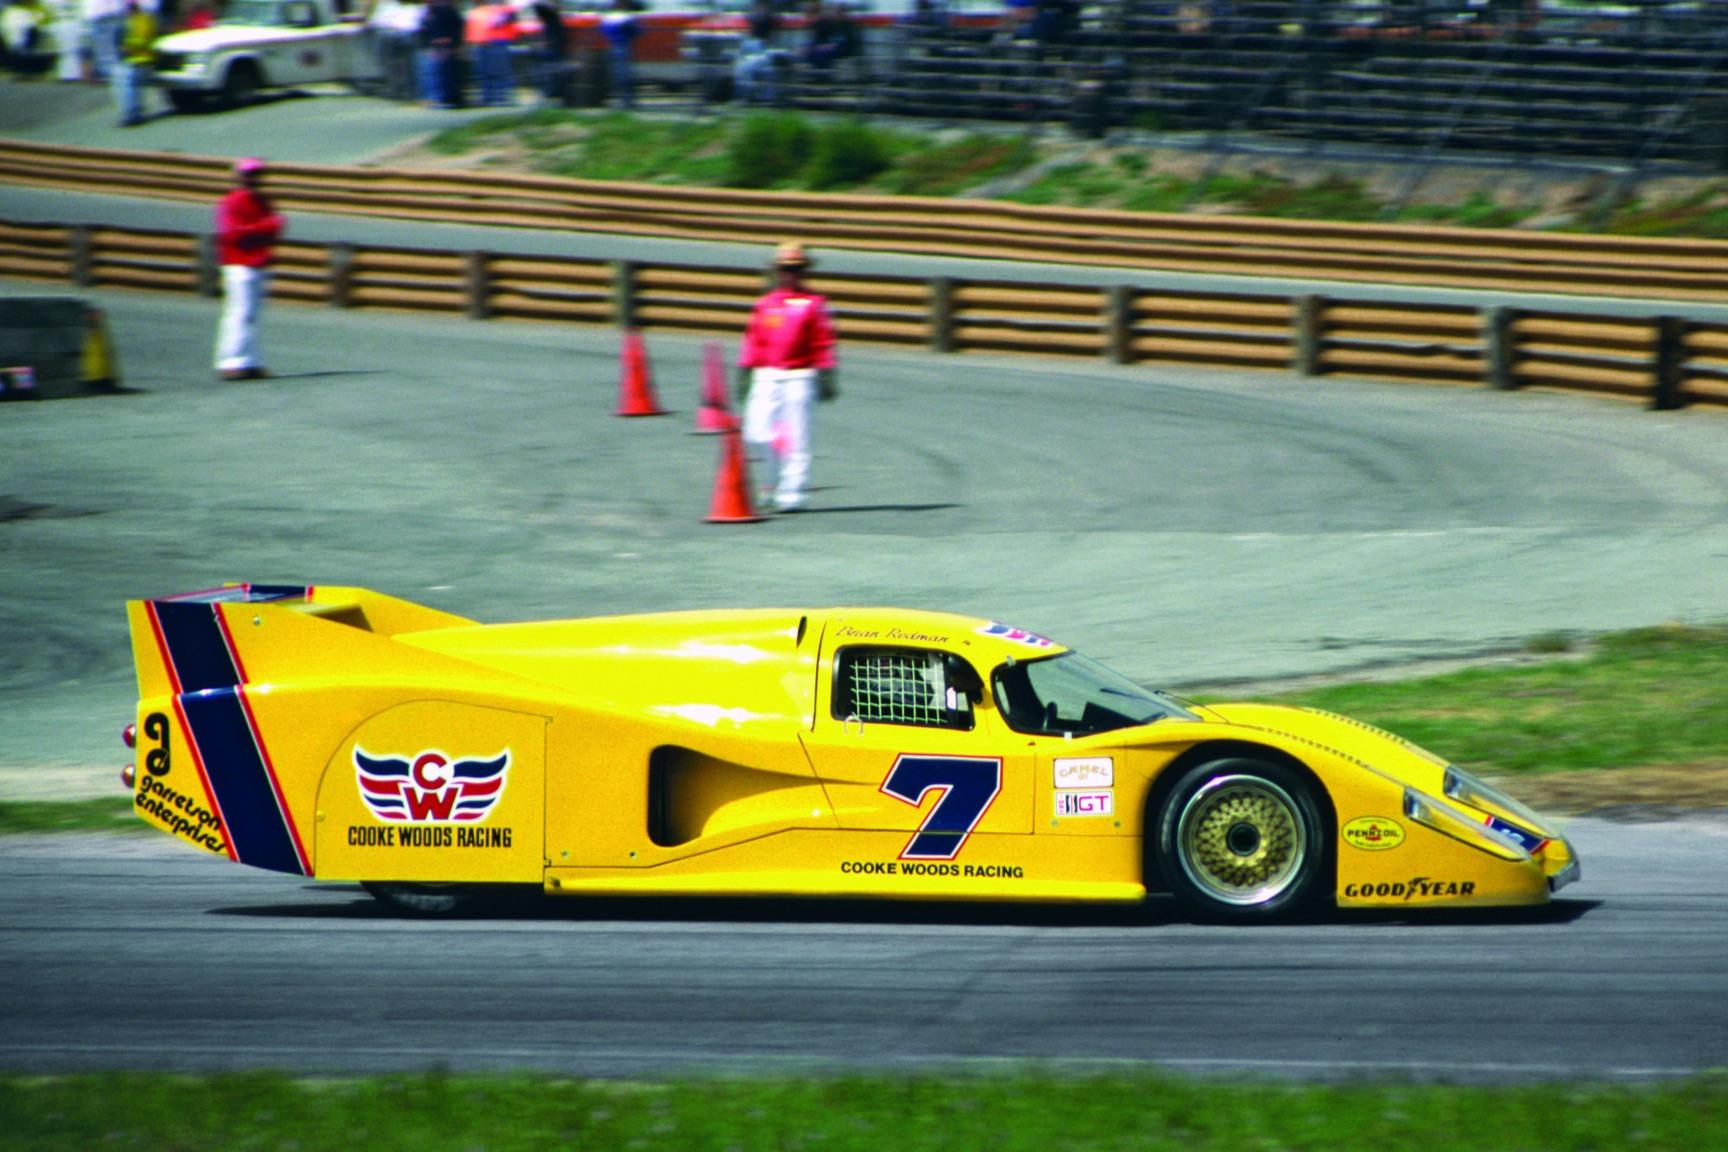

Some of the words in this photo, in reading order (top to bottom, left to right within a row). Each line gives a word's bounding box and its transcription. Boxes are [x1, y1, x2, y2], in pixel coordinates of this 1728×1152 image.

[885, 628, 949, 642] Redman
[1058, 765, 1109, 777] CAMEL
[140, 775, 222, 831] garretson
[878, 752, 1003, 861] 7
[1078, 795, 1109, 811] GT
[134, 793, 226, 853] enterprises
[348, 826, 394, 846] COOKE
[399, 827, 452, 847] WOODS
[457, 827, 512, 847] RACING
[1347, 829, 1400, 838] PENNZOIL
[841, 861, 897, 875] COOKE
[901, 863, 960, 877] WOODS
[963, 864, 1024, 879] RACING
[1344, 879, 1476, 899] GOODYEAR
